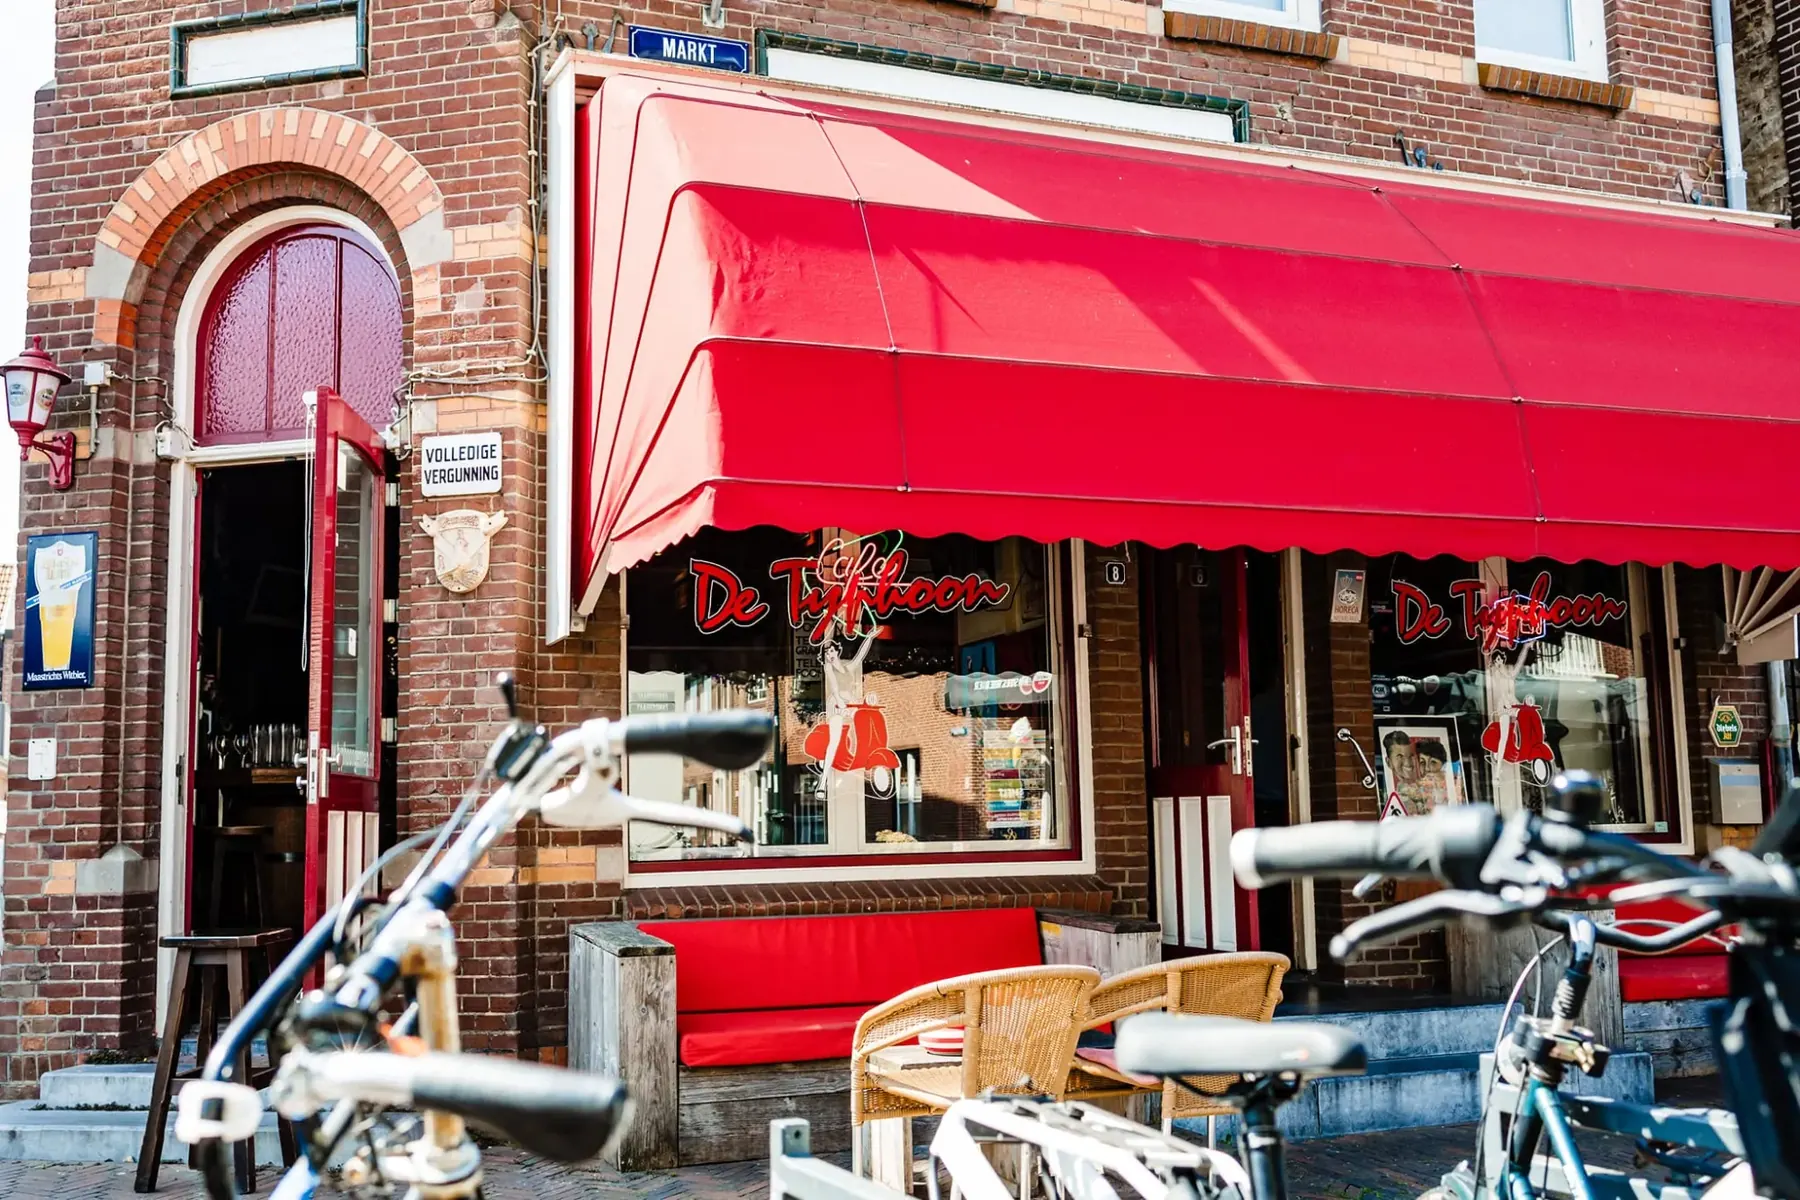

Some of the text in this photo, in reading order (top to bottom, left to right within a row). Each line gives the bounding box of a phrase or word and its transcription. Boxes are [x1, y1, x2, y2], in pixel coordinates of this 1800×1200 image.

[662, 36, 717, 64] MARKT
[425, 443, 497, 463] VOLLEDIGE
[424, 464, 499, 485] VERGUNNING
[690, 548, 1011, 646] De Typhoon
[1391, 579, 1452, 645] De
[1450, 571, 1628, 655] Typhoon
